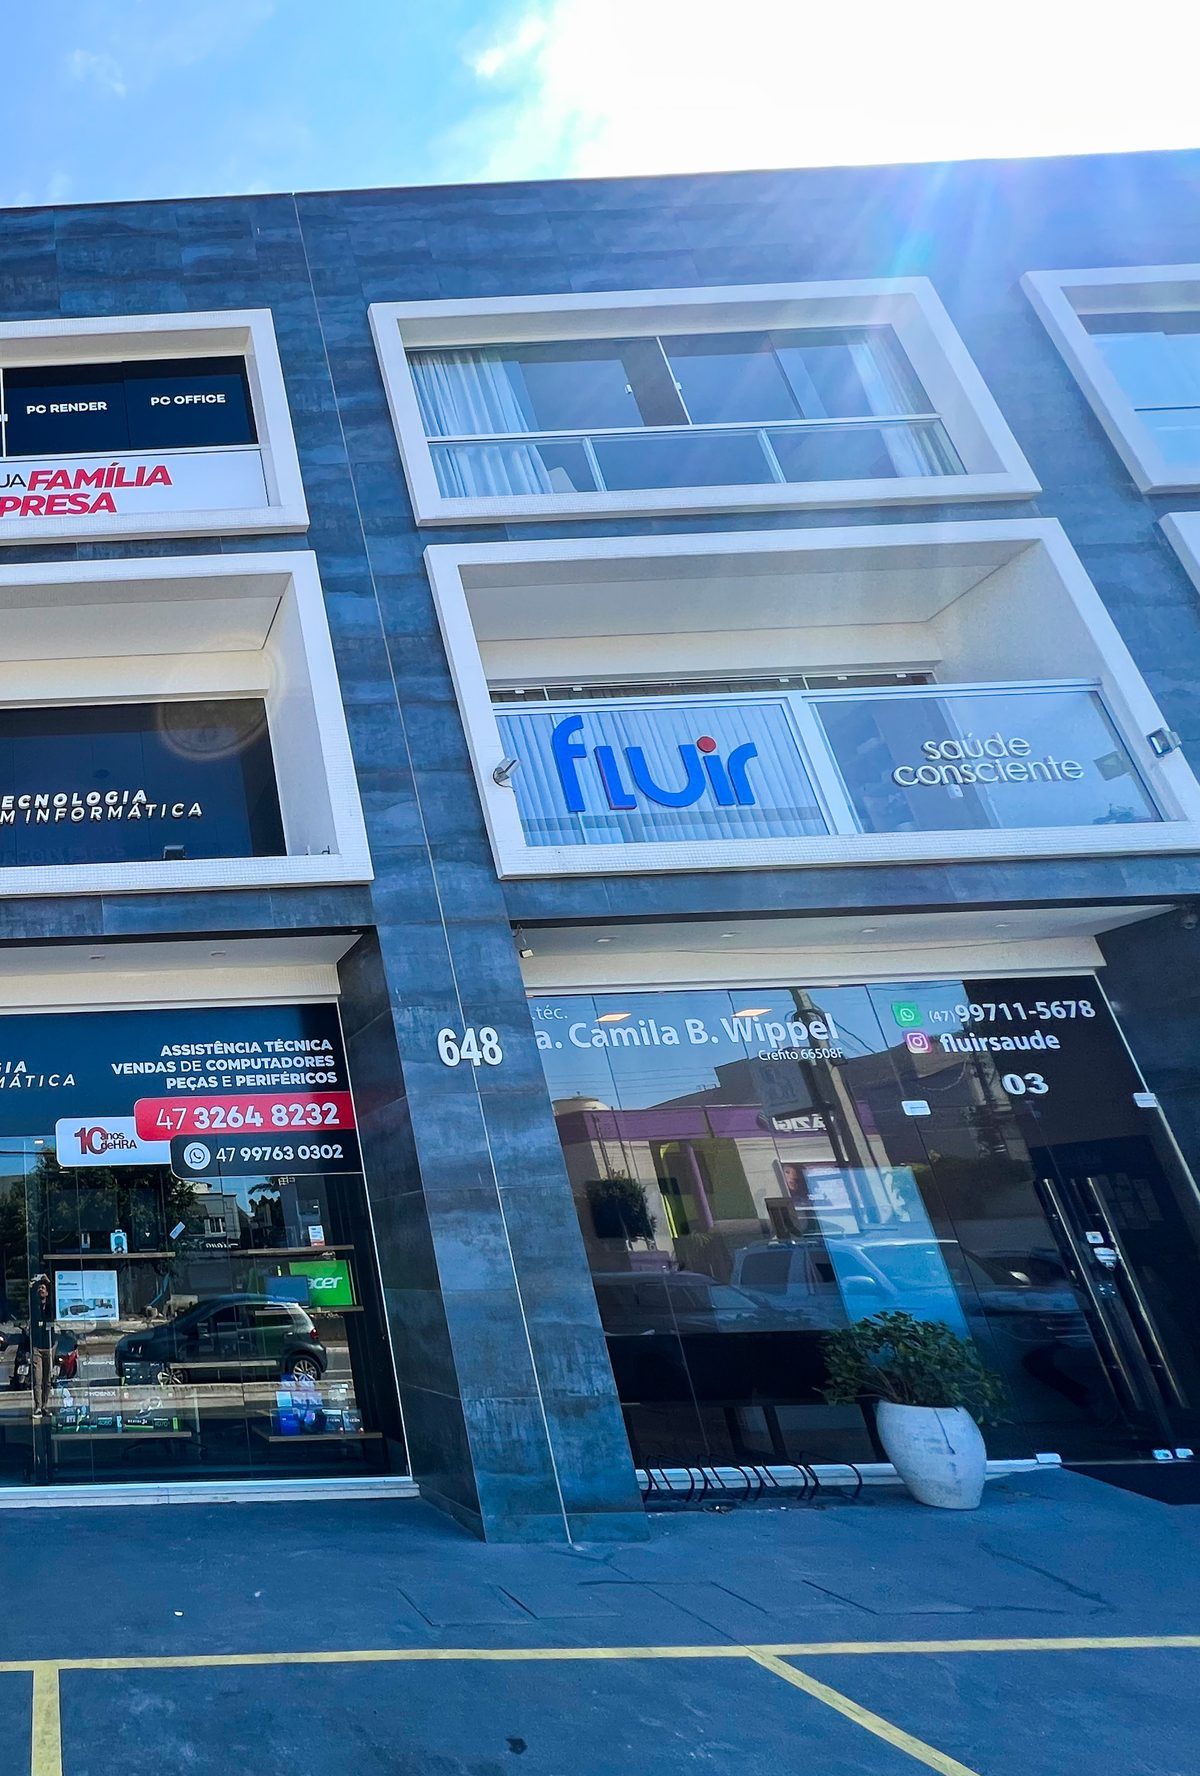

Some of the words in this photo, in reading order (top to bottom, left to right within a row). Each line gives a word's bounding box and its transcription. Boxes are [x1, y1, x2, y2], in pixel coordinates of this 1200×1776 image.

[26, 404, 47, 415] PC
[50, 401, 108, 413] RENDER
[150, 396, 171, 406] PC
[173, 393, 226, 405] OFFICE
[27, 461, 173, 492] FAMÍLIA
[922, 732, 1032, 761] saúde
[892, 755, 1085, 787] consciente
[24, 801, 203, 825] INFORMÁTICA
[568, 1018, 680, 1049] Camila
[685, 1018, 719, 1045] B.
[719, 1012, 839, 1049] Wippel
[939, 1029, 1062, 1053] fluirsaude
[160, 1040, 262, 1057] ASSISTÊNCIA
[263, 1038, 333, 1053] TÉCNICA
[437, 1026, 503, 1067] 648
[758, 1048, 799, 1061] Crefito
[111, 1061, 177, 1075] VENDAS
[180, 1060, 203, 1072] DE
[205, 1055, 336, 1071] COMPUTADORES
[166, 1076, 218, 1091] PEÇAS
[222, 1075, 233, 1087] E
[235, 1071, 338, 1087] PERIFÉRICOS
[1001, 1071, 1050, 1096] 03
[156, 1107, 188, 1130] 47
[193, 1105, 264, 1129] 3264
[271, 1102, 340, 1127] 8232
[74, 1126, 109, 1155] 10
[100, 1131, 125, 1140] anos
[216, 1147, 236, 1163] 47
[240, 1146, 294, 1161] 99763
[297, 1145, 344, 1160] 0302
